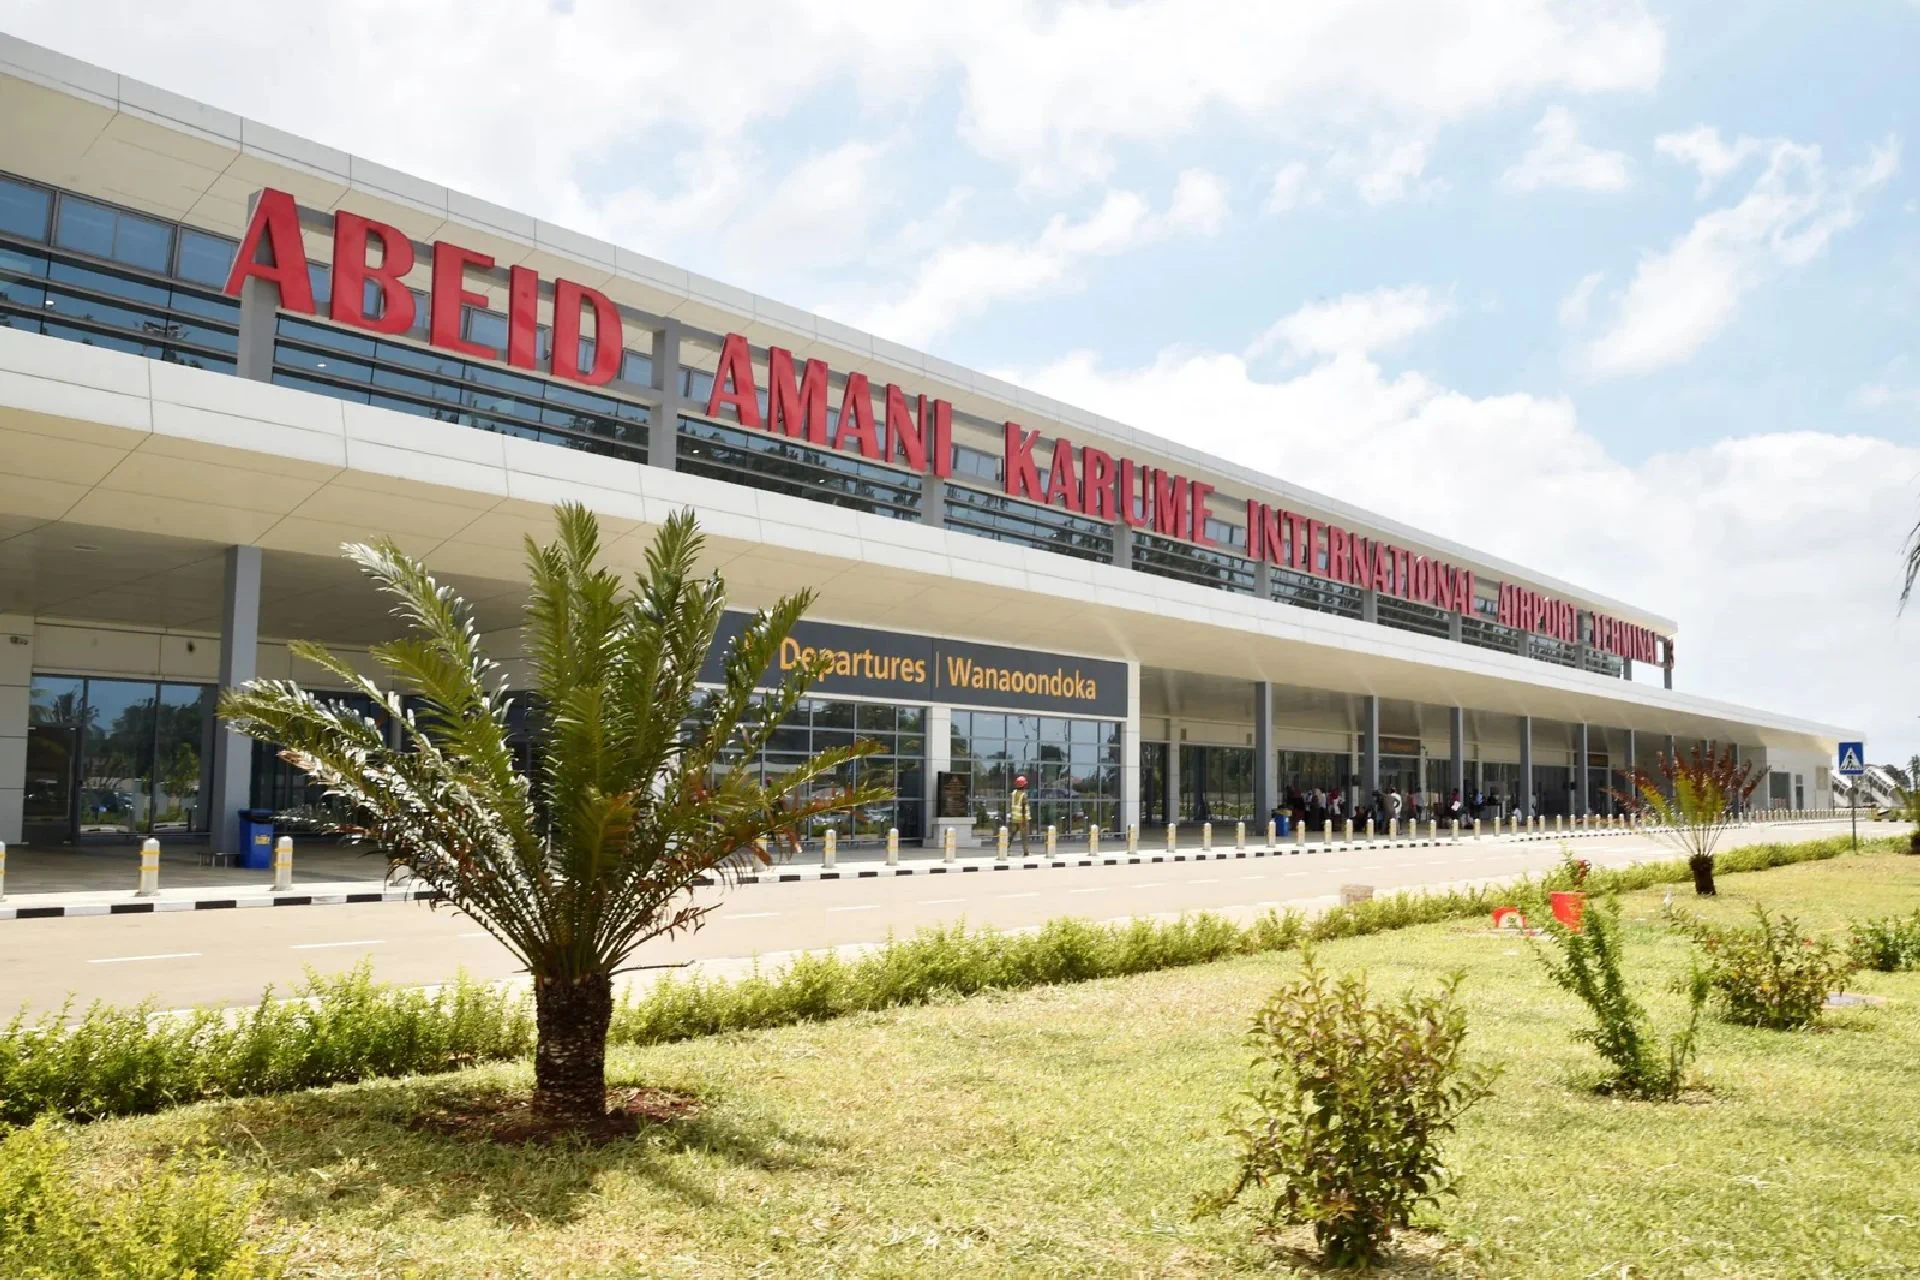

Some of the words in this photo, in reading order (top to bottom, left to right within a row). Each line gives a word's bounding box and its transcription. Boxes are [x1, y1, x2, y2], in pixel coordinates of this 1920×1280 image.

[223, 186, 624, 386] ABEID
[706, 332, 952, 479] AMANI
[1003, 420, 1217, 547] KARUME
[1247, 498, 1480, 617] INTERNATIONAL
[1496, 581, 1578, 644] AIRPORT
[1590, 611, 1660, 666] TERMINAL
[779, 637, 927, 683] Departures
[947, 656, 1097, 700] Wanaoondoka
